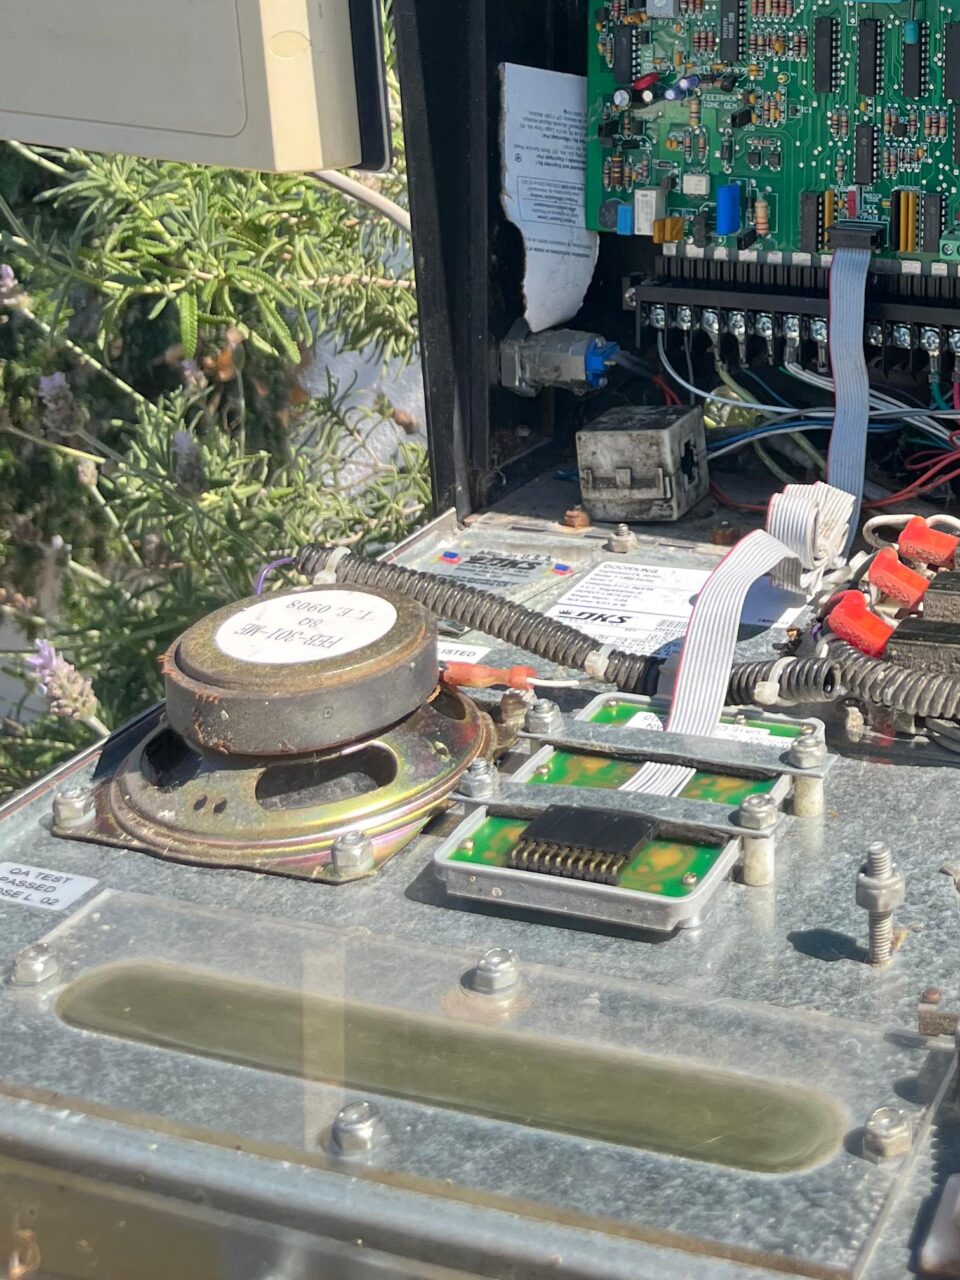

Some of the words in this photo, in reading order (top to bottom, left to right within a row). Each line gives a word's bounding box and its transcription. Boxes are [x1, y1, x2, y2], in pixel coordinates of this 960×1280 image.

[438, 648, 477, 657] ISTED
[9, 867, 31, 877] QA
[34, 871, 73, 884] TEST
[40, 896, 60, 906] 02
